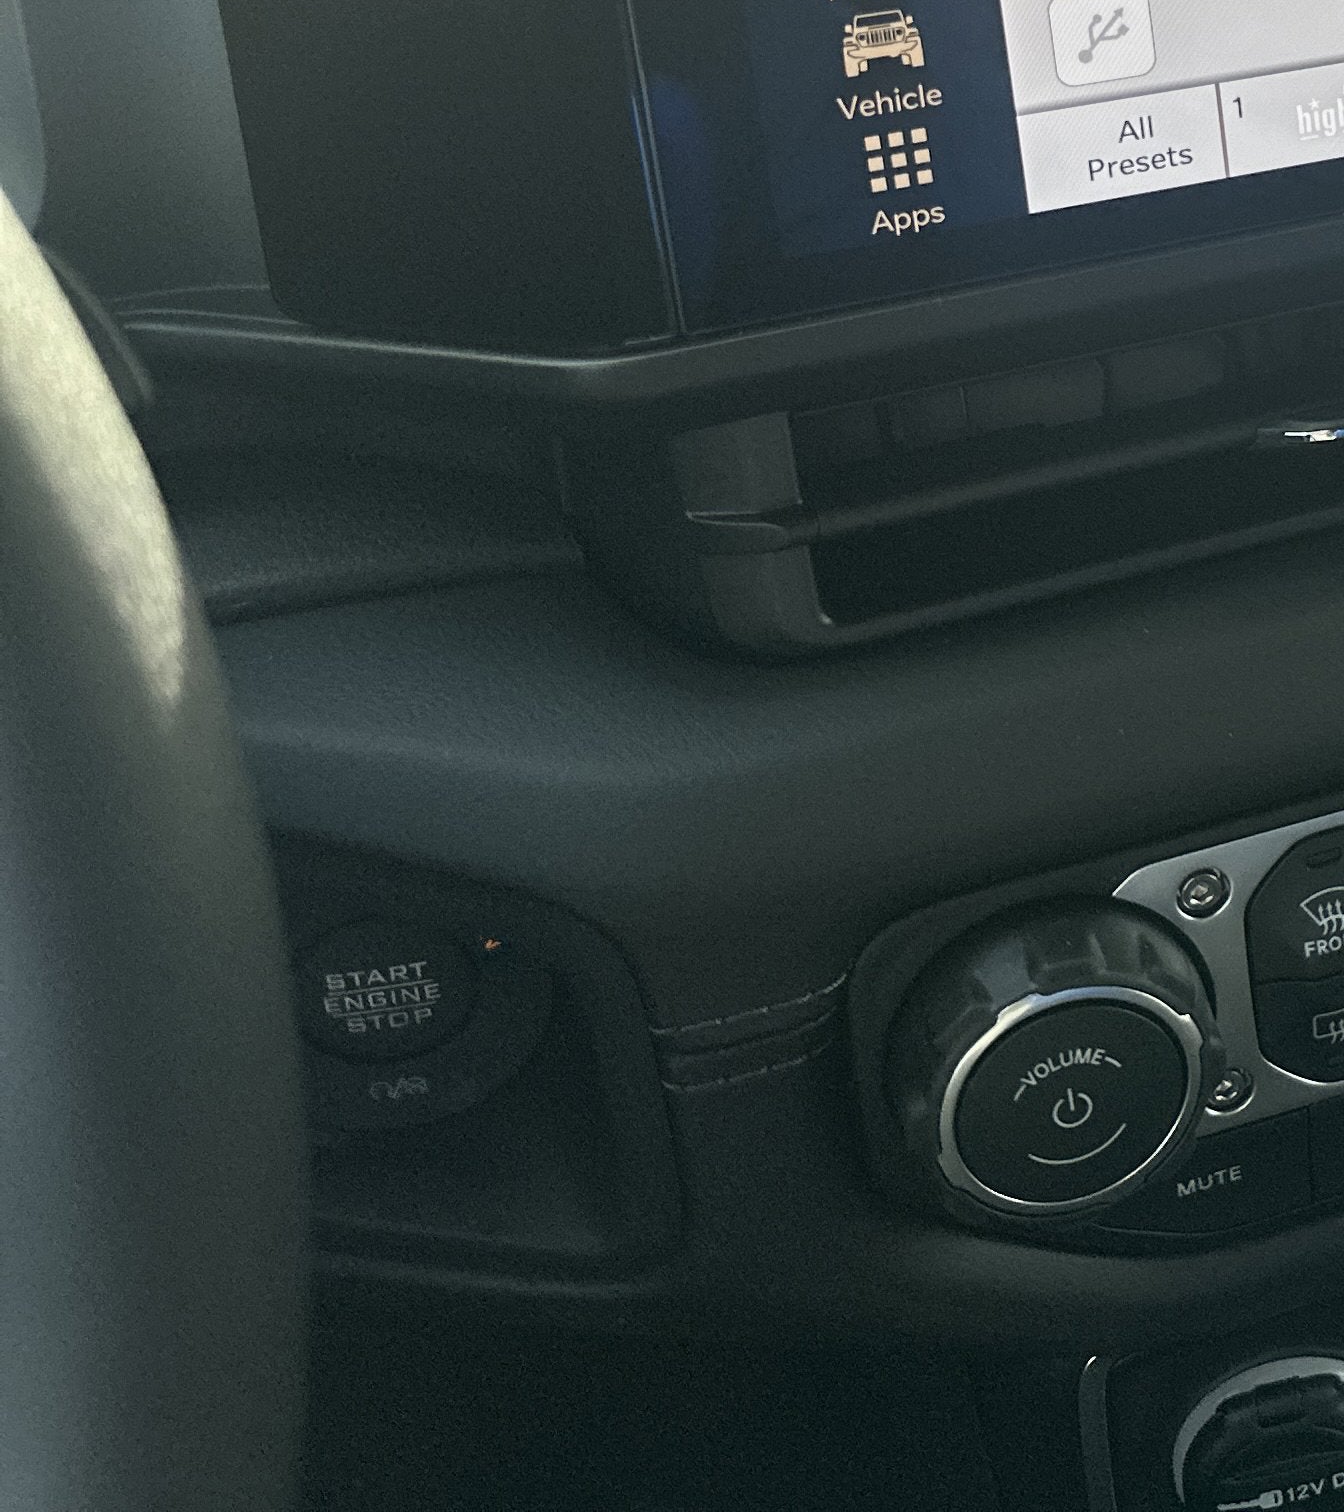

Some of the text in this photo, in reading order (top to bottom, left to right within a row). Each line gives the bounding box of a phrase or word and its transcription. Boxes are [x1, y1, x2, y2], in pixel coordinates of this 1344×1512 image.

[836, 84, 944, 120] Vehicle
[1233, 95, 1244, 118] 1
[1118, 115, 1155, 143] All
[1087, 144, 1194, 181] Presets
[870, 201, 946, 236] Apps
[326, 961, 427, 989] START
[324, 983, 441, 1013] ENGINE
[348, 1008, 433, 1033] STOP
[1023, 1048, 1107, 1088] VOLUME
[1176, 1165, 1243, 1197] MUTE
[1286, 1478, 1325, 1502] 12V
